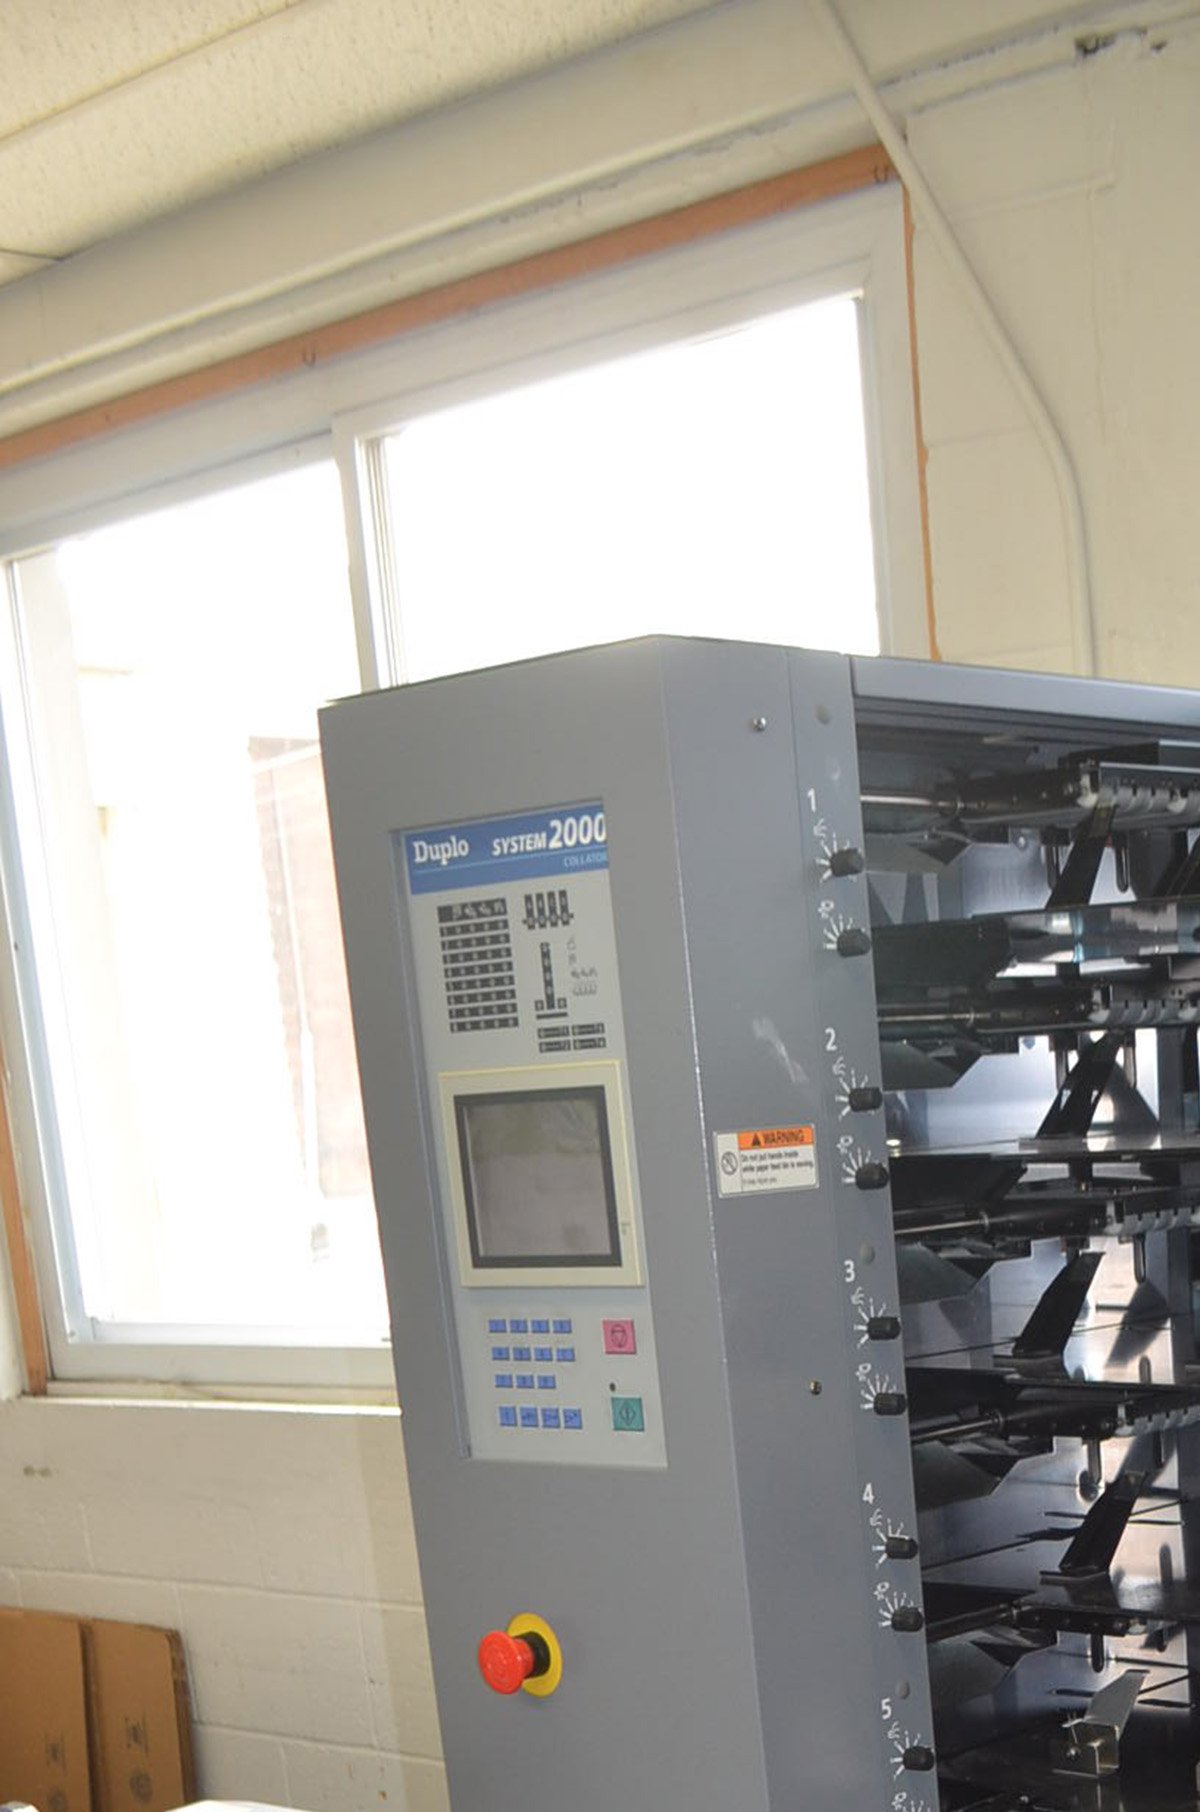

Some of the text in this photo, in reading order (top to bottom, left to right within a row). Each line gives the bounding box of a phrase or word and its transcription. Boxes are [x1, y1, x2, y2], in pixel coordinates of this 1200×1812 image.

[806, 788, 816, 813] 1
[491, 812, 607, 857] SYSTEM 2000
[412, 834, 470, 866] Duplo
[824, 1027, 837, 1052] 2
[763, 1129, 805, 1145] WARNING
[843, 1259, 855, 1283] 3
[862, 1482, 874, 1504] 4
[880, 1698, 892, 1720] 5
